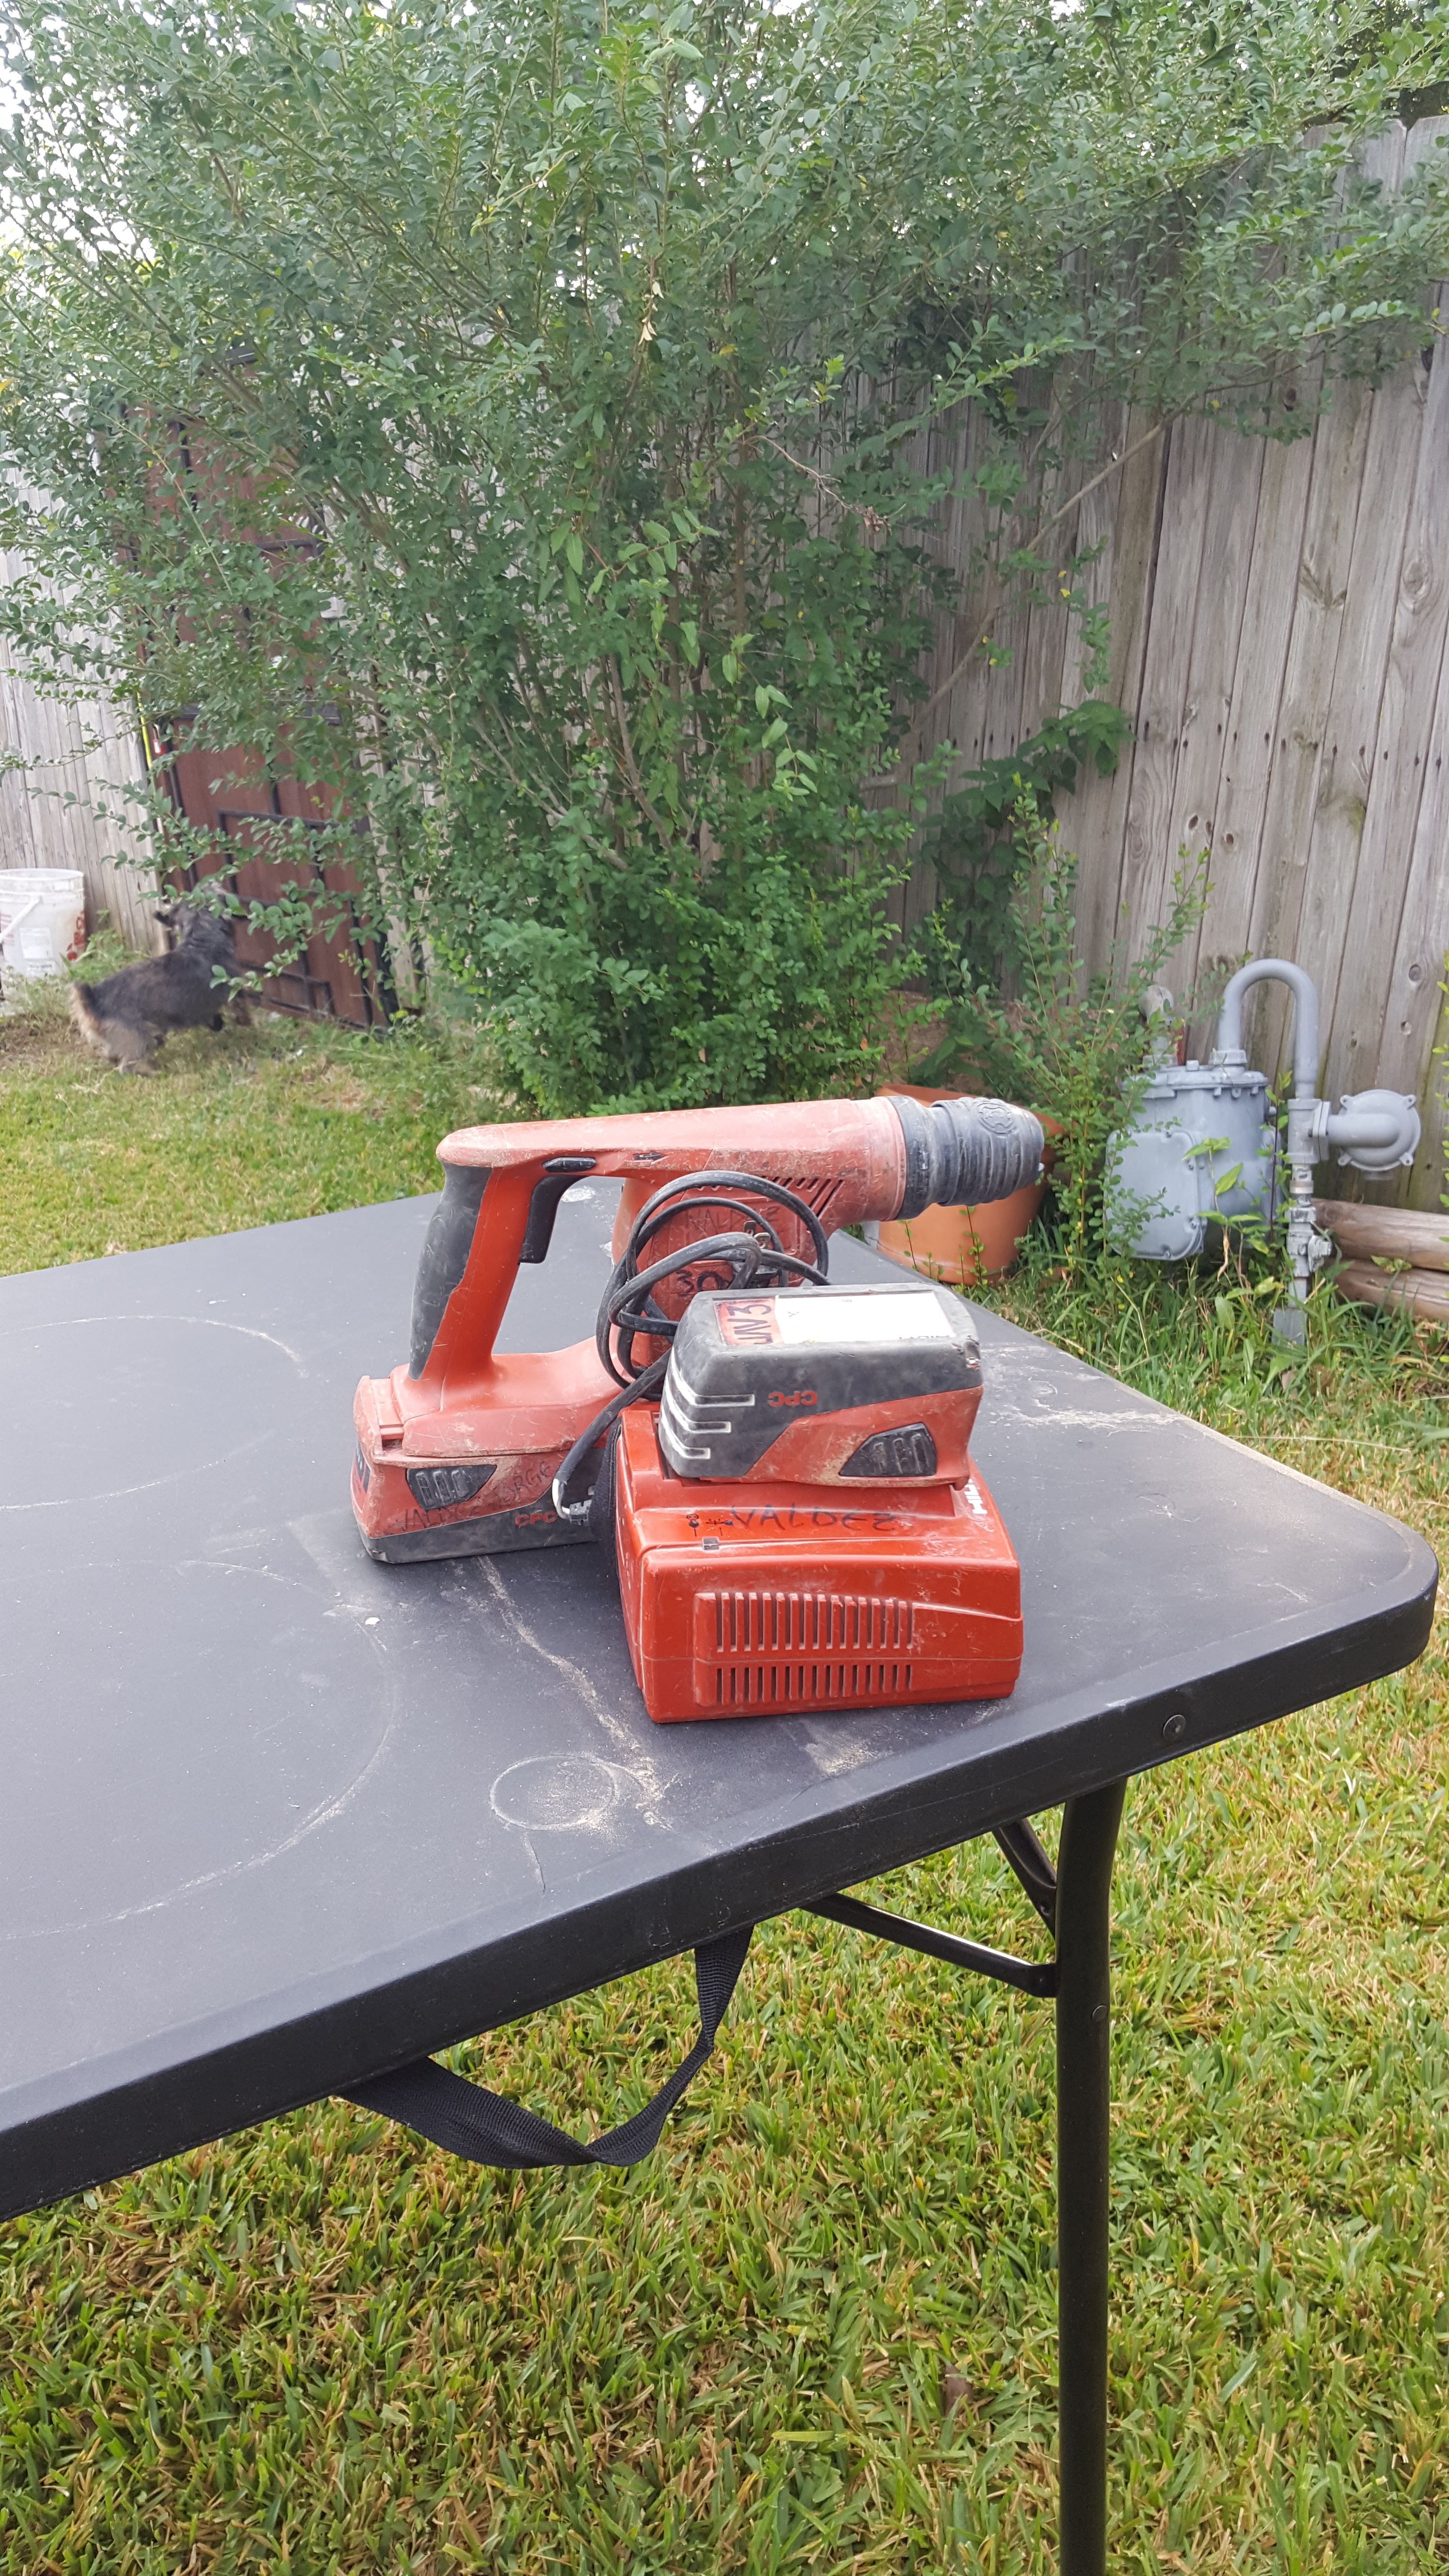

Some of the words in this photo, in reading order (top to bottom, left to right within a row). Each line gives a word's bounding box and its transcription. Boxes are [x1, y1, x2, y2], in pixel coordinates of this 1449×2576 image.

[768, 1390, 818, 1407] CPC
[515, 1511, 557, 1527] CPC
[731, 1502, 897, 1531] VALDEZ
